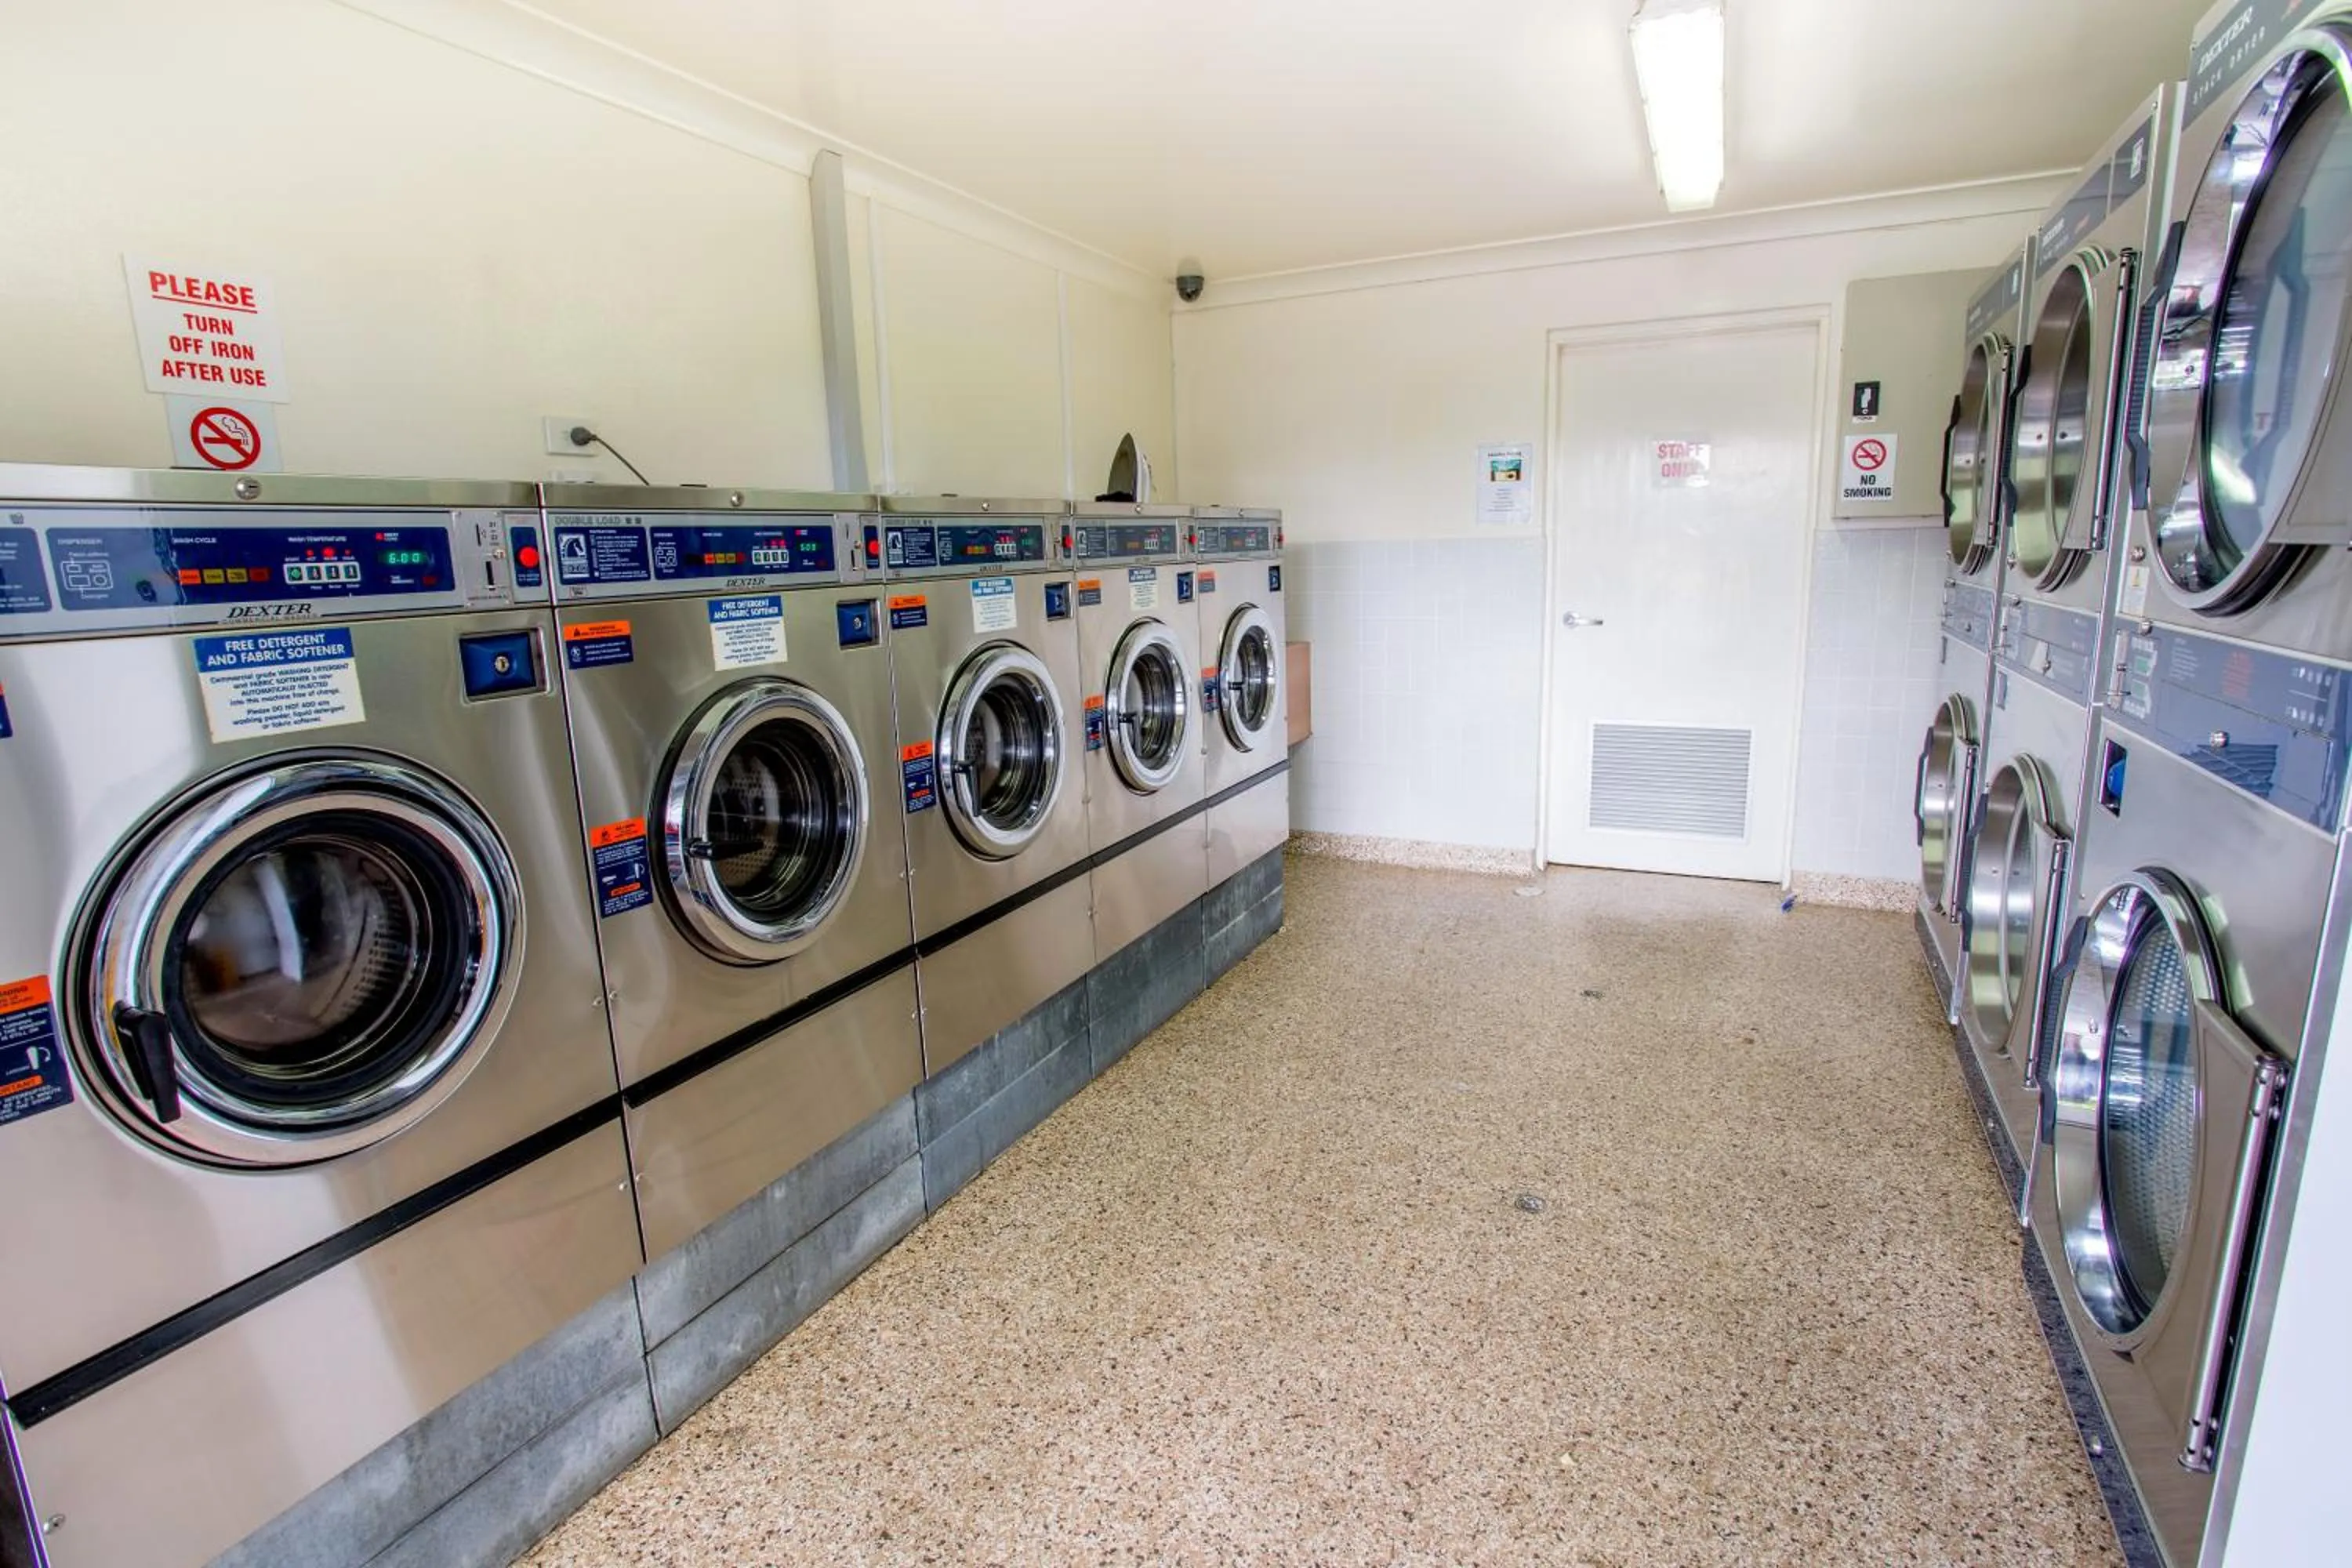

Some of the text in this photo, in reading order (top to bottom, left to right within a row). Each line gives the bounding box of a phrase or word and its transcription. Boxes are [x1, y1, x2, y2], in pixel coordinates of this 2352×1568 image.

[149, 270, 256, 307] PLEASE
[183, 313, 234, 336] TURN
[169, 335, 255, 361] OFF IRON
[162, 359, 267, 387] AFTER USE
[1657, 442, 1704, 459] STAFF
[1860, 474, 1876, 485] NO
[1843, 487, 1892, 498] SMOKING
[227, 603, 313, 619] DEXTER
[225, 633, 325, 652] FREE DETERGENT
[207, 644, 346, 666] AND FABRIC SOFTENER
